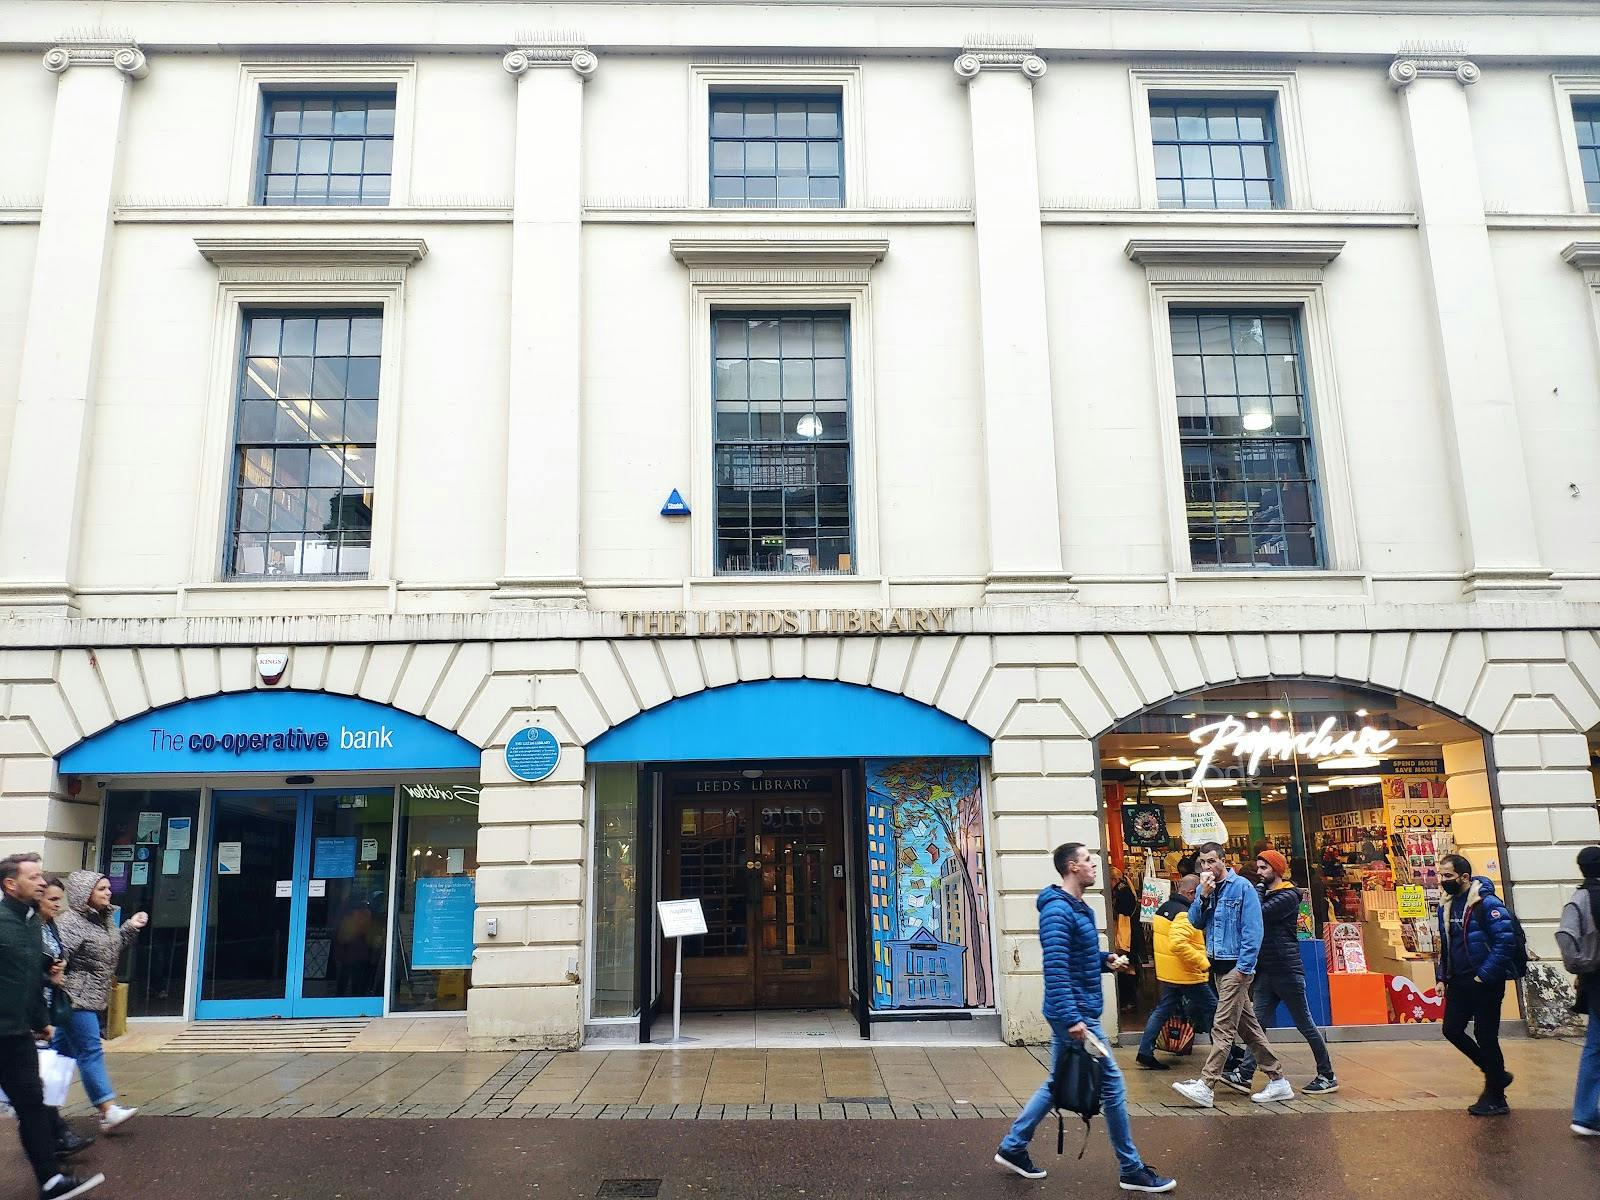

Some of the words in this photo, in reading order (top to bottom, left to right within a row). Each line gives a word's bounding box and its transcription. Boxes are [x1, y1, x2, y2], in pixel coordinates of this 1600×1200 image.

[621, 610, 687, 634] THE
[698, 609, 800, 634] LEEDS
[808, 608, 952, 633] LIBRARY
[149, 728, 185, 752] The
[188, 727, 330, 756] co-operative
[339, 725, 394, 750] bank
[696, 780, 741, 792] LEEDS
[751, 779, 811, 791] LIBRARY
[1323, 812, 1360, 829] CELEBRATE
[1393, 814, 1421, 828] £10
[1422, 814, 1452, 828] OFF
